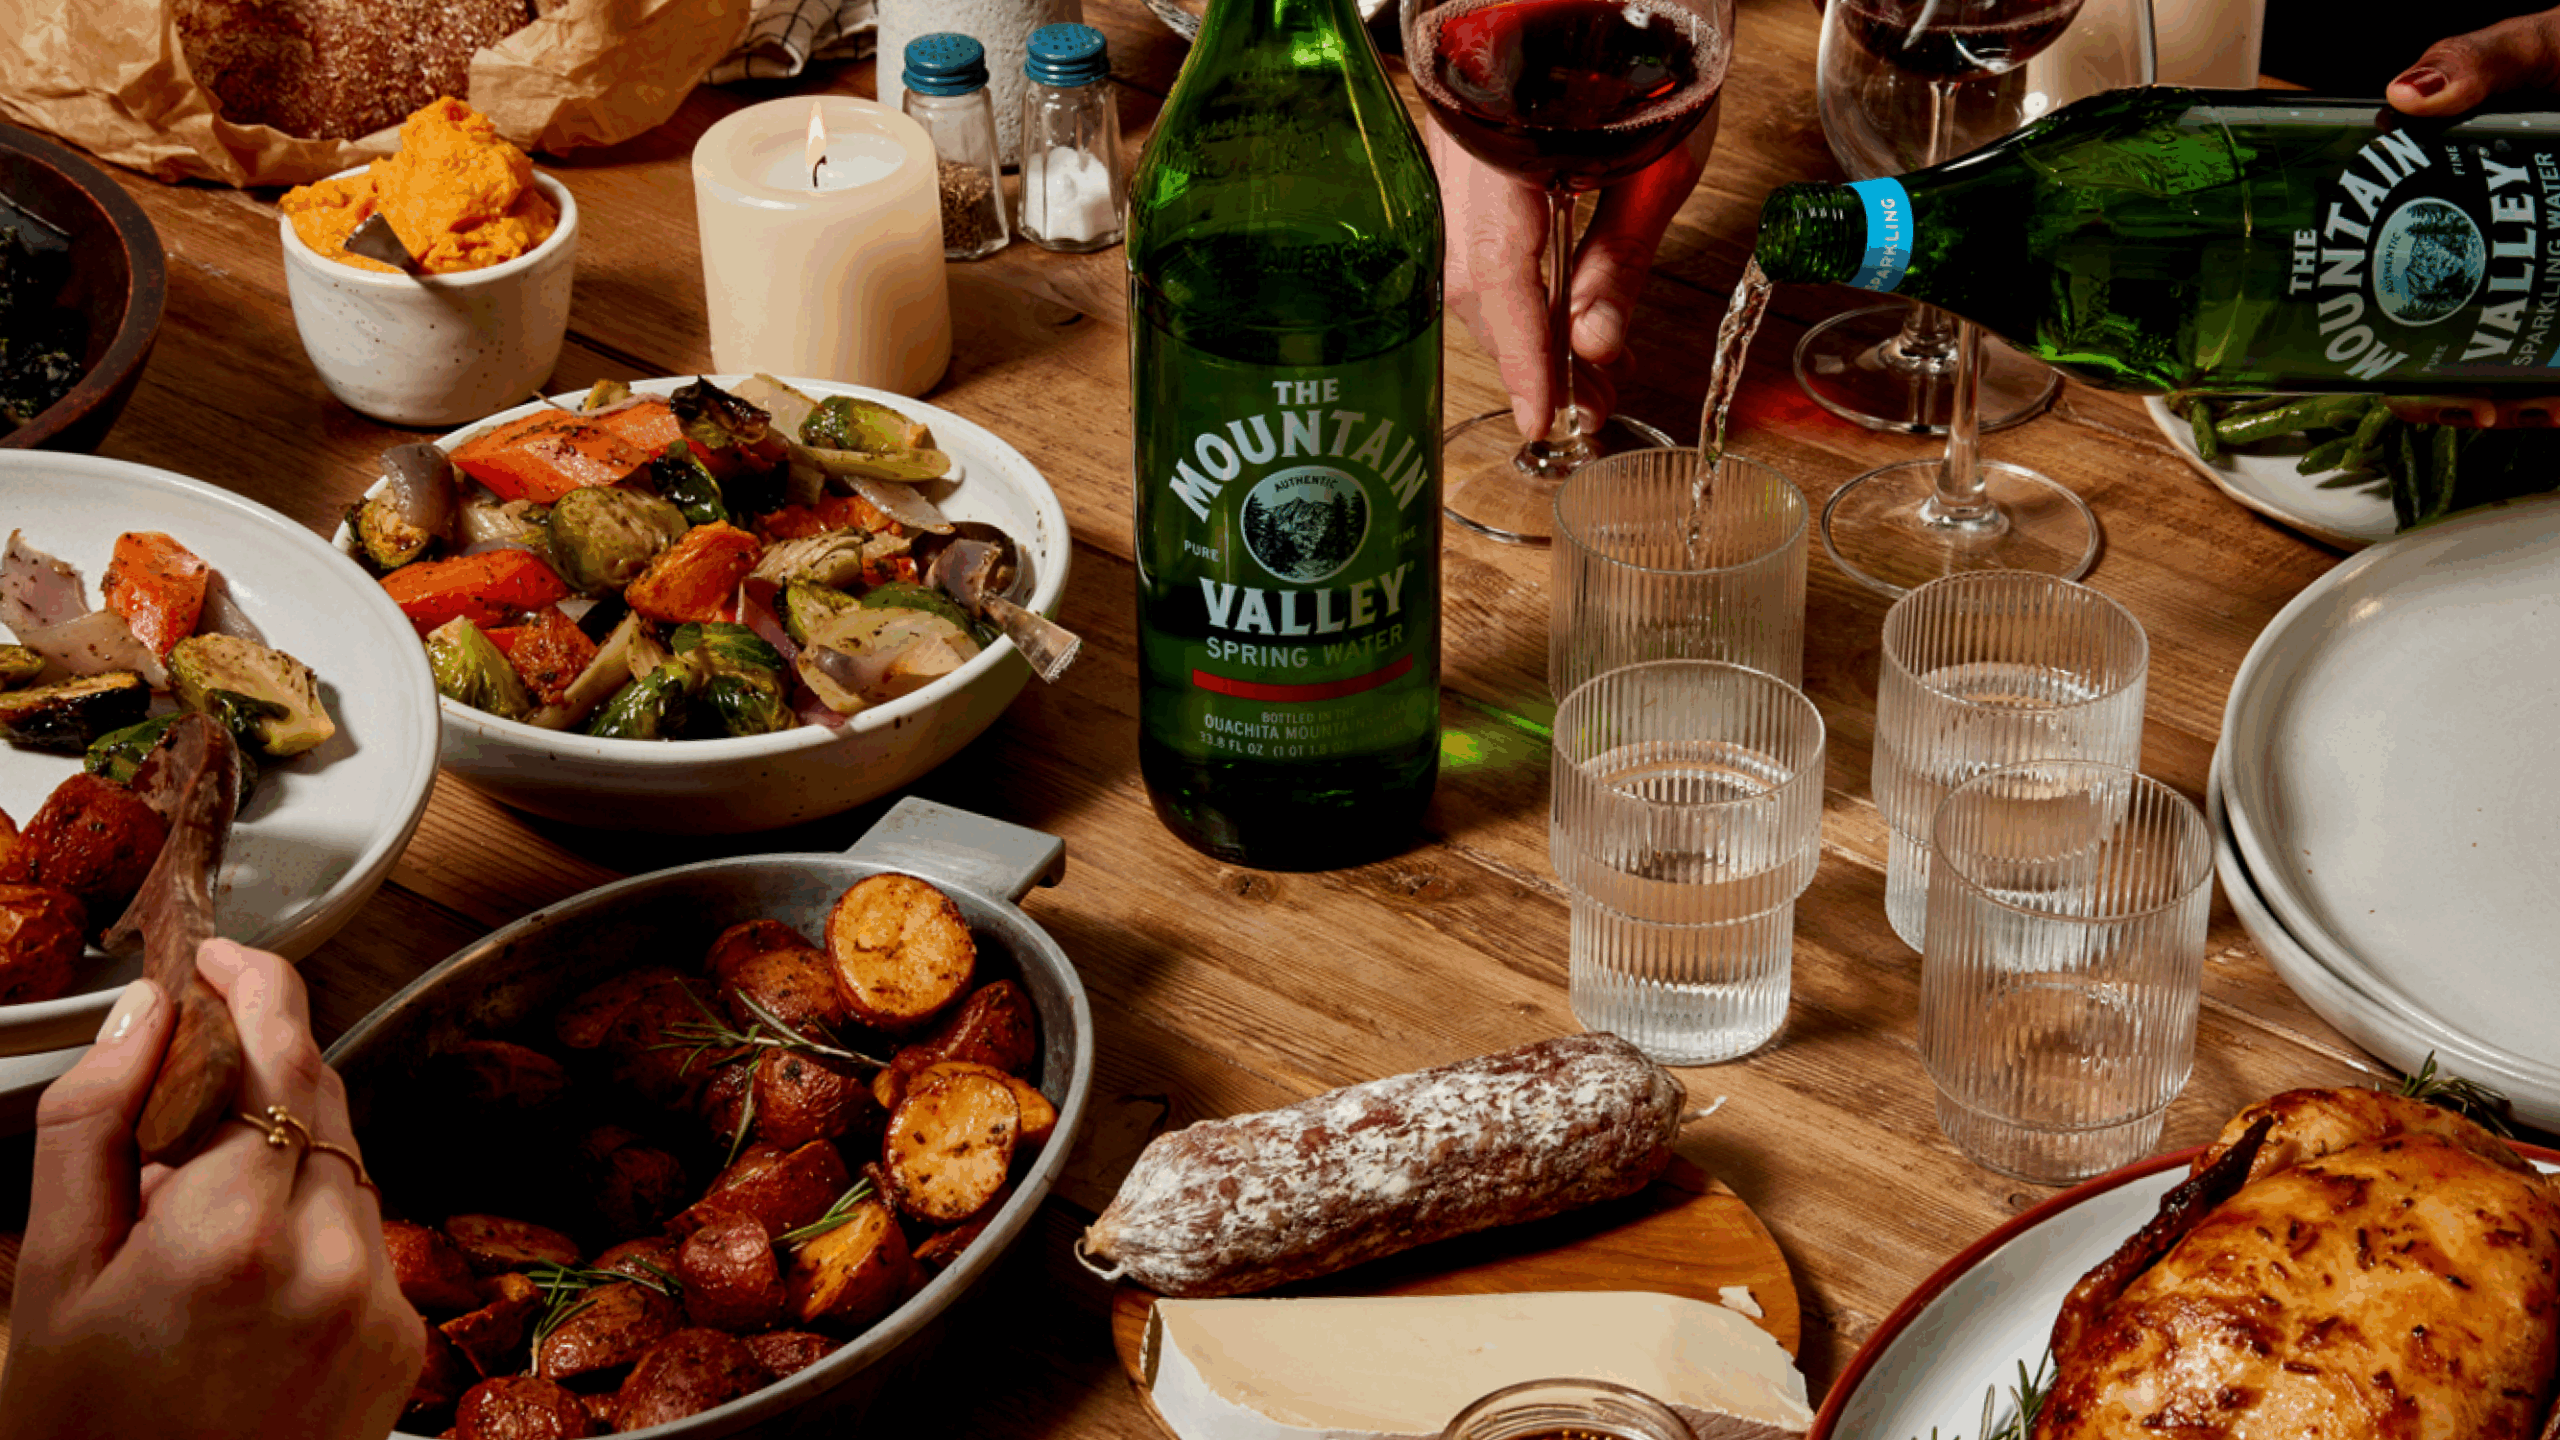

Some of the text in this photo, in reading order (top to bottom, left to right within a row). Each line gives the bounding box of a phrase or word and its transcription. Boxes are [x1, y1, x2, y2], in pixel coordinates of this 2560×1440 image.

[2445, 145, 2466, 176] FINE
[2289, 229, 2318, 295] THE
[2318, 128, 2431, 381] MOUNTAIN
[2512, 151, 2560, 367] SPARKLING WATER
[1272, 377, 1339, 406] THE
[1169, 409, 1428, 523] MOUNTAIN
[1184, 540, 1220, 563] PURE
[1391, 525, 1417, 549] FINE
[1206, 623, 1403, 668] SPRING WATER
[1204, 713, 1280, 740] OUACHITA
[1261, 711, 1314, 725] BOTTLED
